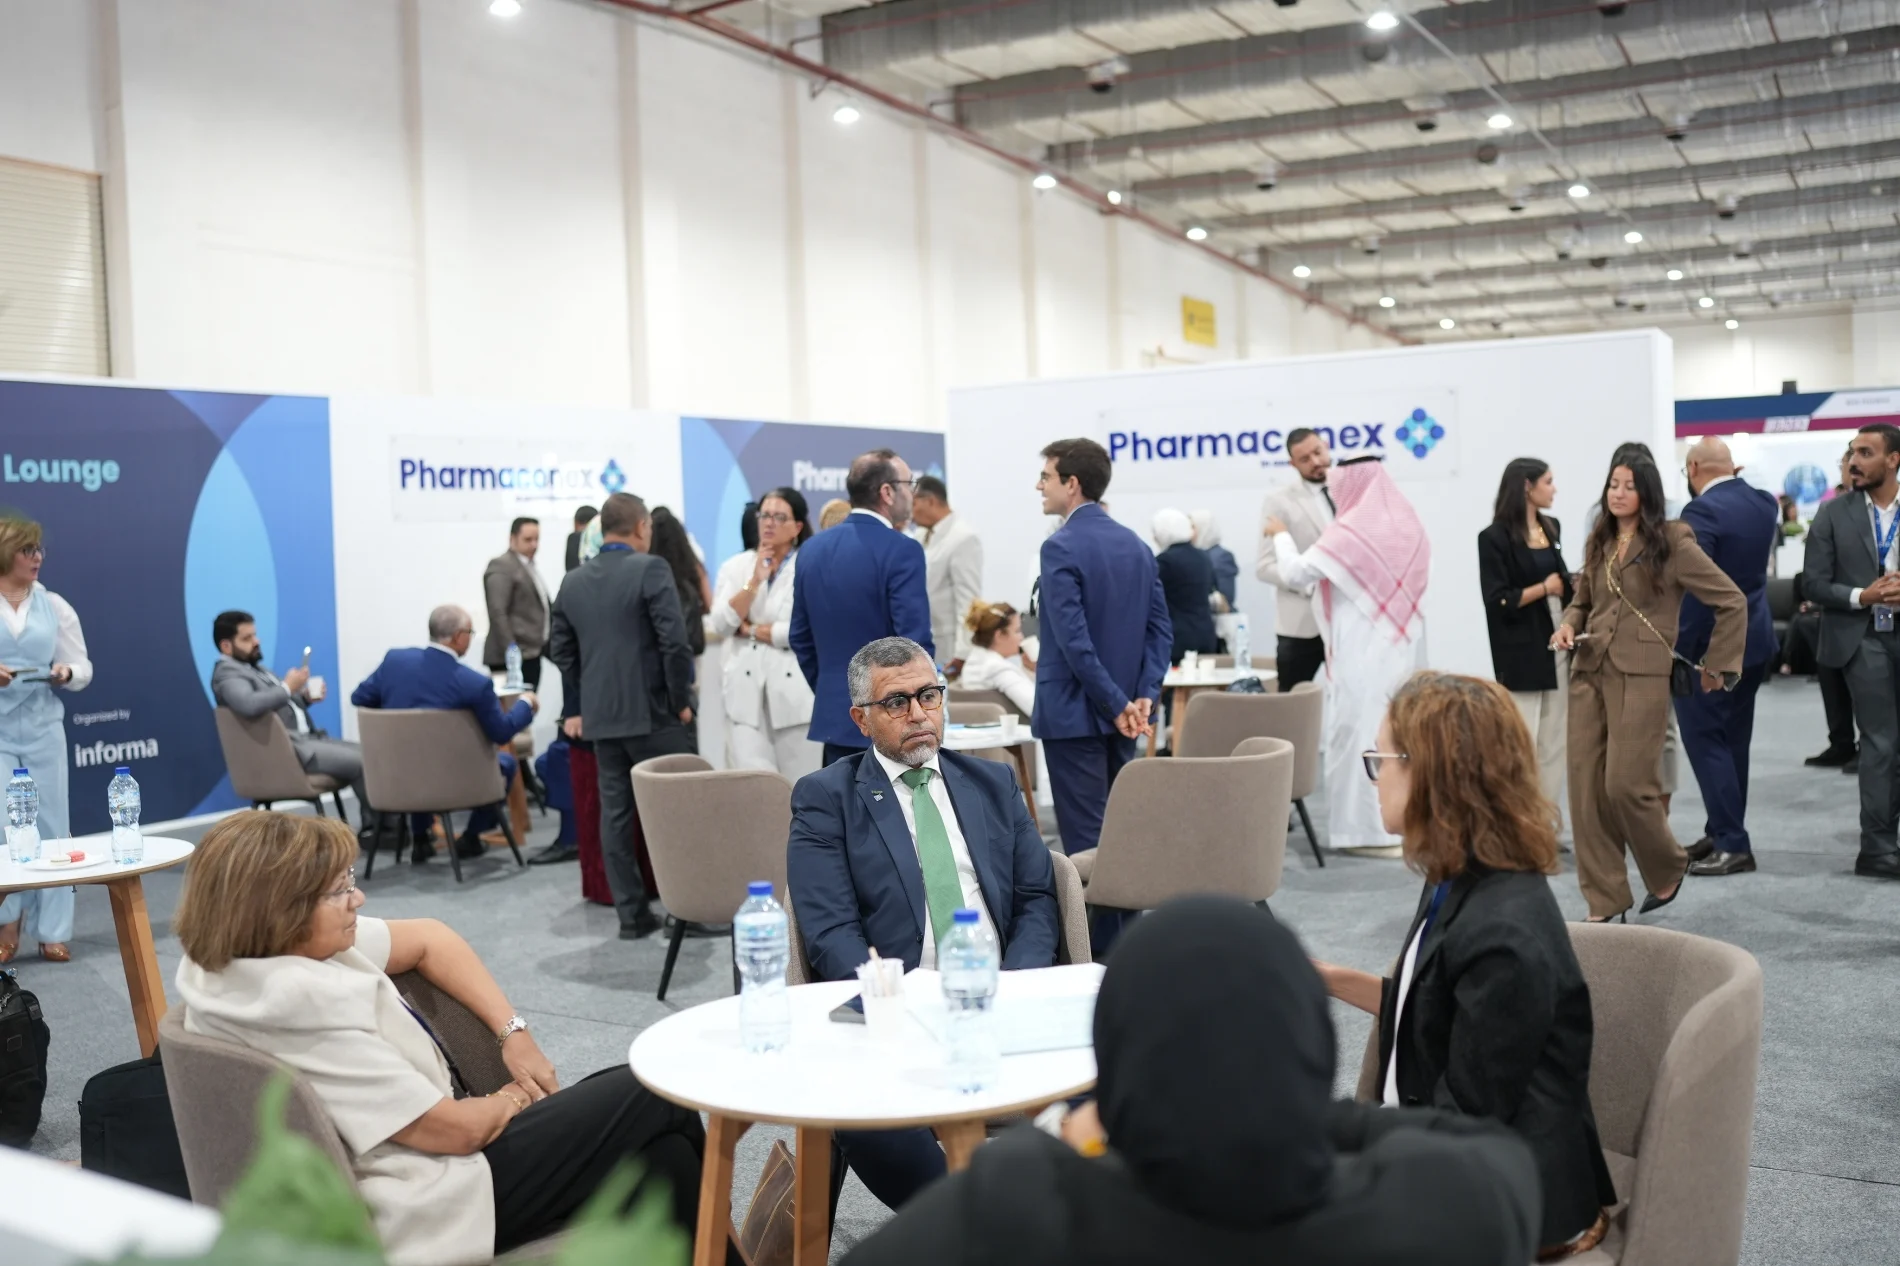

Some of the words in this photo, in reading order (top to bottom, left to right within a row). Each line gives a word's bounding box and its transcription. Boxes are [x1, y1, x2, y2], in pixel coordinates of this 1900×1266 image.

[1109, 422, 1384, 461] Pharmacnex
[3, 453, 120, 492] Lounge
[74, 738, 159, 768] informa
